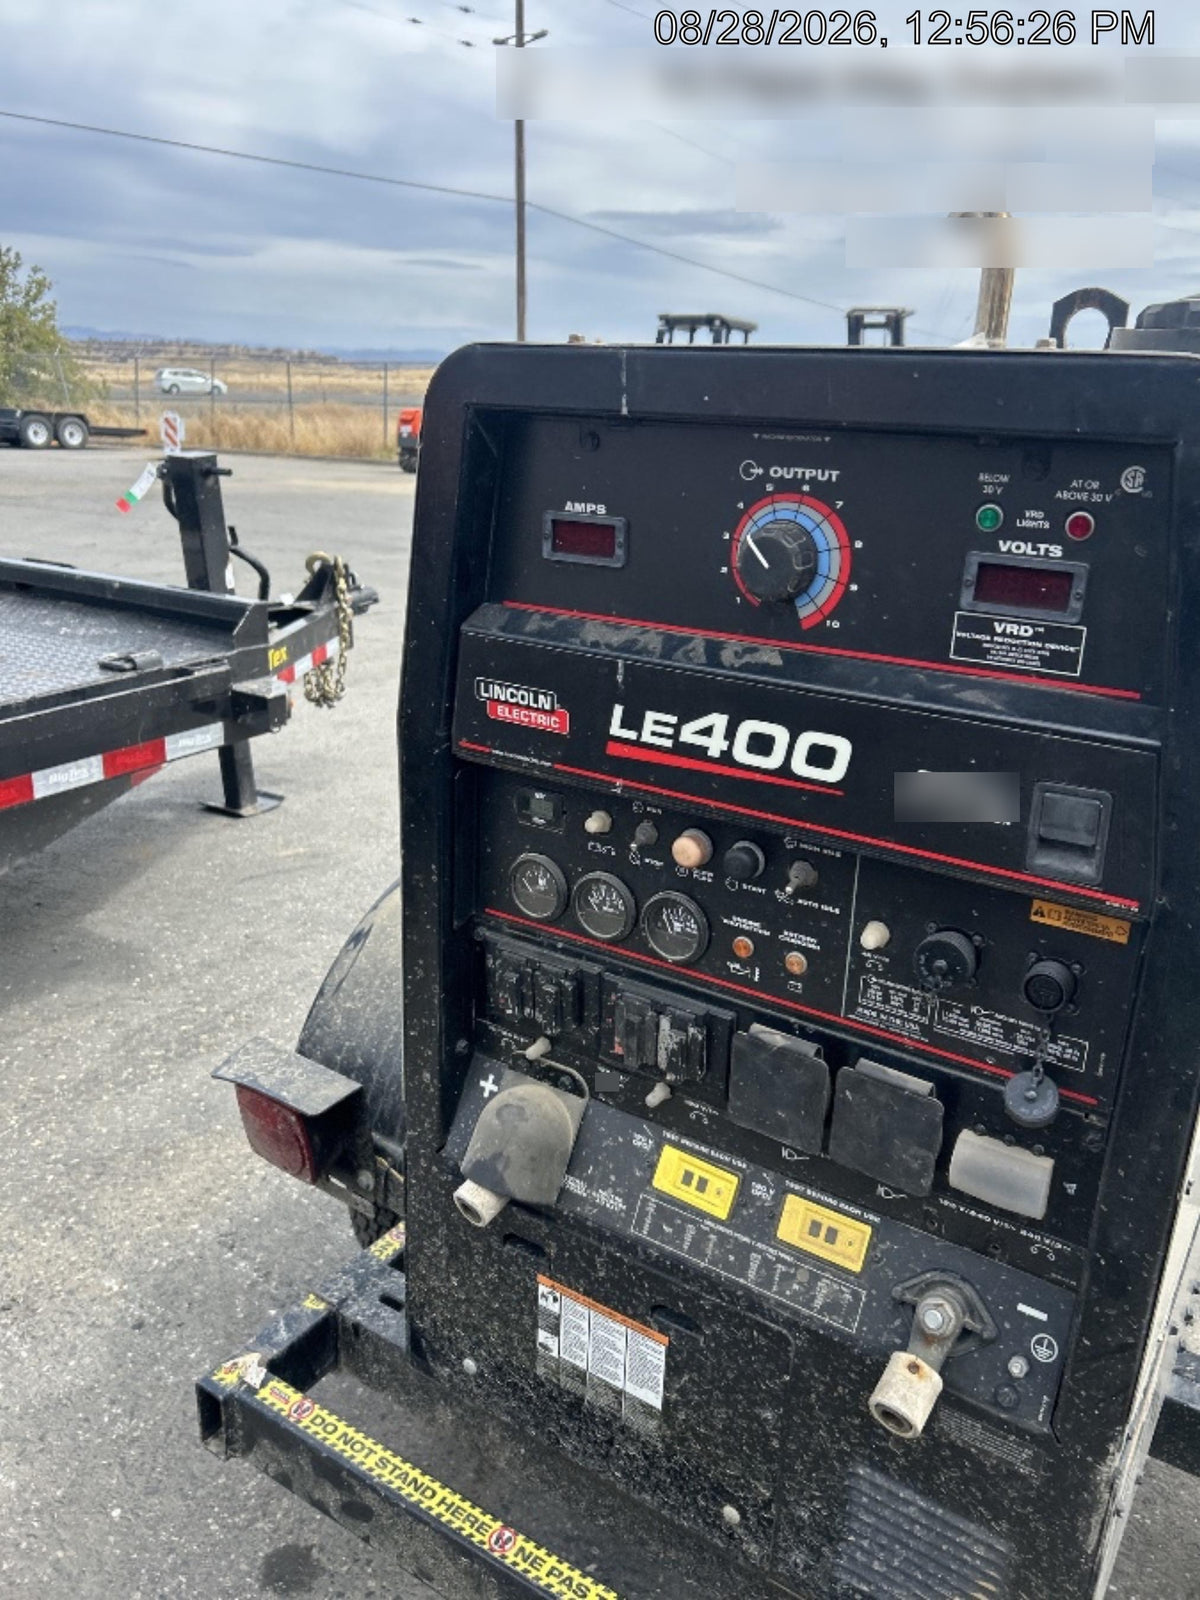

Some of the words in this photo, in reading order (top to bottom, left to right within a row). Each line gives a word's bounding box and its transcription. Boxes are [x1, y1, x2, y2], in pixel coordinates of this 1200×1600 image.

[769, 466, 840, 482] OUTPUT
[1070, 479, 1084, 489] AT
[1084, 480, 1100, 490] OR
[1055, 490, 1090, 501] ABOVE
[565, 501, 607, 515] AMPS
[834, 500, 844, 509] 7
[1025, 509, 1044, 519] VRD
[1016, 518, 1050, 529] LIGHTS
[998, 539, 1063, 557] VOLTS
[826, 619, 840, 629] 10
[479, 681, 552, 710] LINCOLN
[496, 705, 560, 729] ELECTRIC
[608, 702, 853, 784] LE400
[309, 1413, 339, 1436] DO
[336, 1433, 378, 1460] NOT
[374, 1455, 438, 1500] STAND
[436, 1495, 493, 1537] HERE
[513, 1545, 547, 1572] NE
[545, 1565, 592, 1600] PAS
